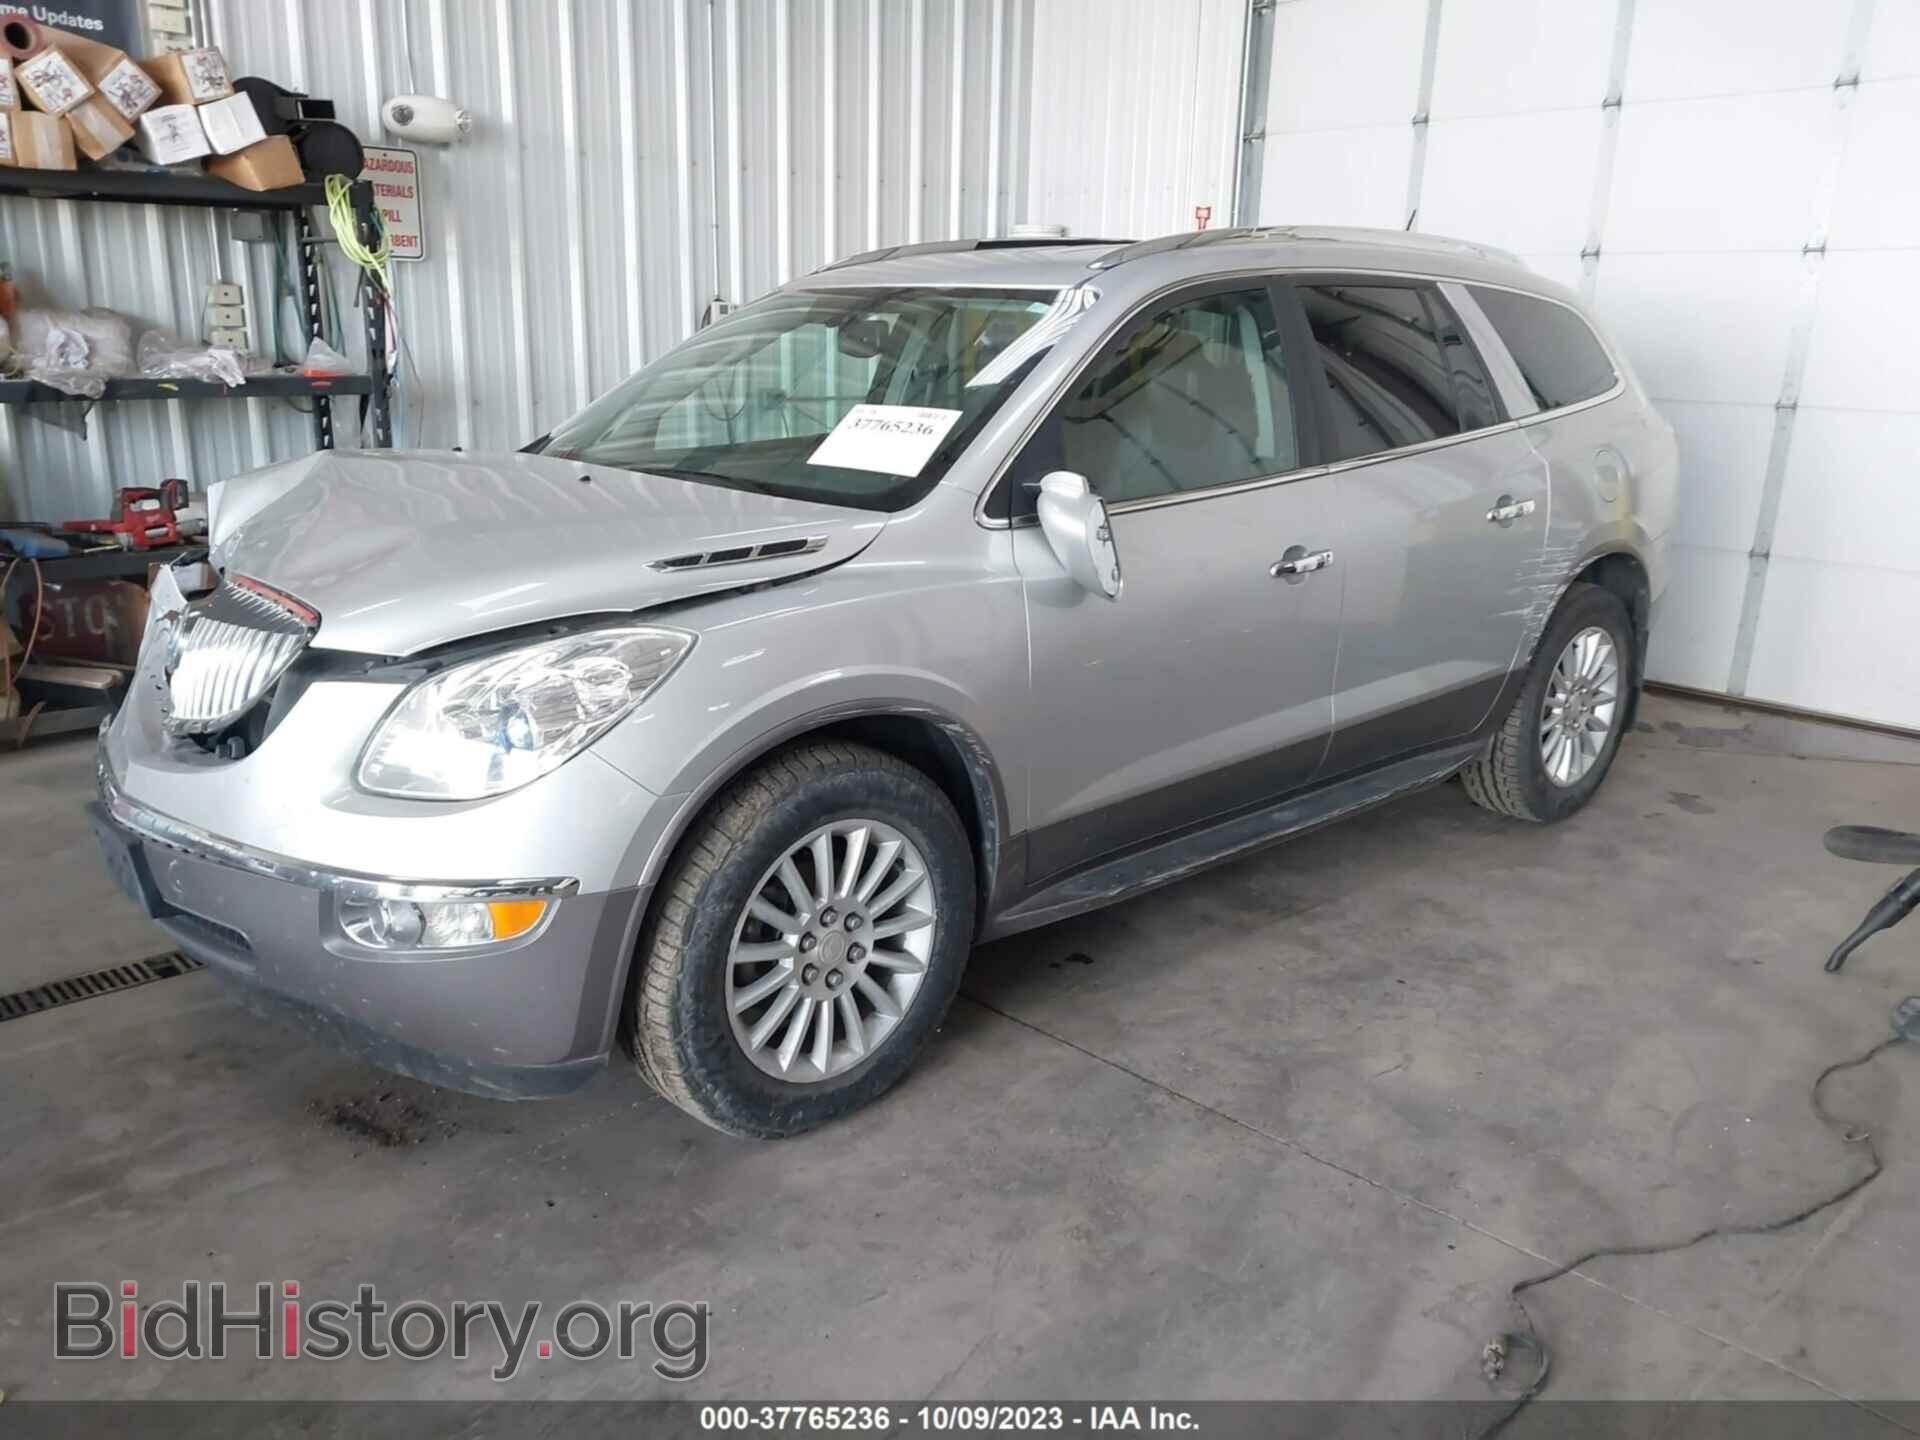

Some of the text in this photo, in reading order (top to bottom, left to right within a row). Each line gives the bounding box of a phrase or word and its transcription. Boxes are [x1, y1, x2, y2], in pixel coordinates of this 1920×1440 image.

[32, 5, 104, 31] Updates
[362, 157, 414, 174] AZARDOUS
[374, 183, 414, 199] TERIALS
[382, 208, 402, 222] PILL
[847, 417, 935, 435] 37765236
[30, 595, 117, 641] STO
